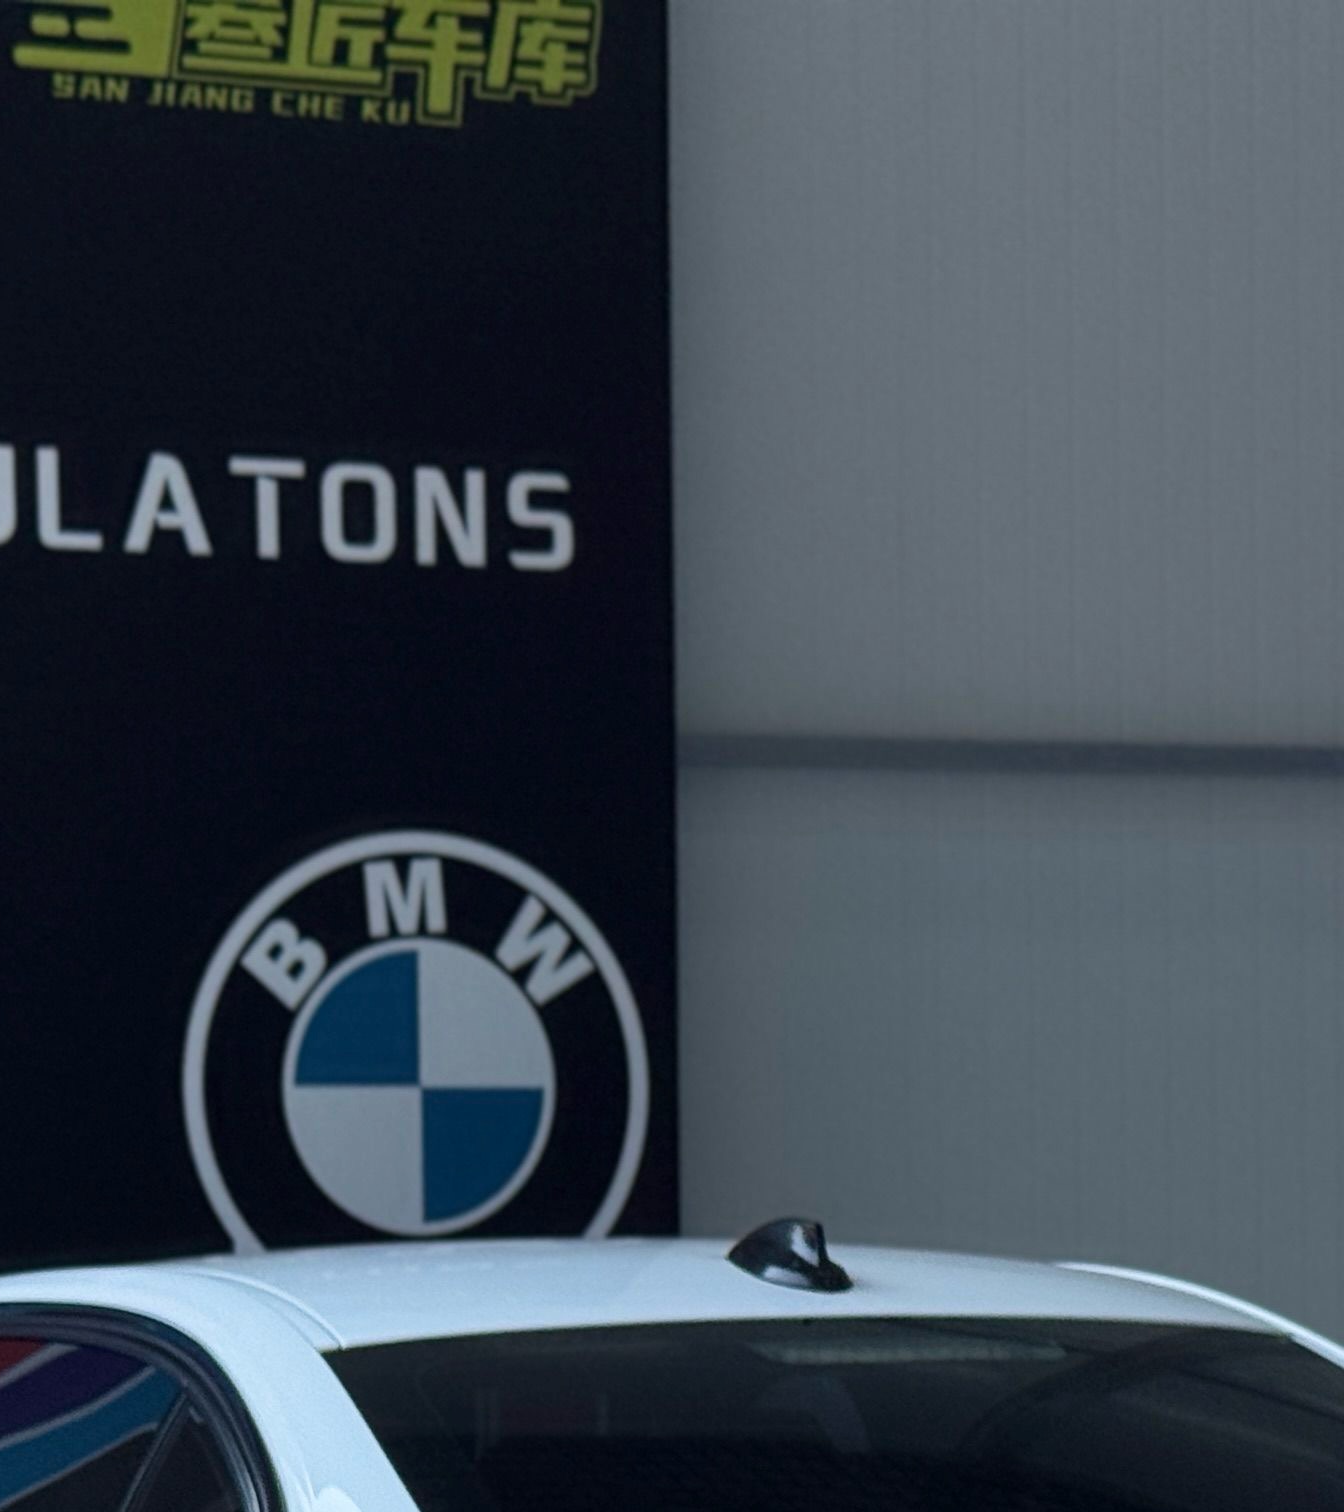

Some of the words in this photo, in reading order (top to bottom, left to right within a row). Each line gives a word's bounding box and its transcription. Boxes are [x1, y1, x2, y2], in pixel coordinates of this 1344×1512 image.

[51, 72, 131, 104] SAN
[147, 80, 255, 114] JIANG
[270, 89, 345, 122] CHE
[360, 98, 411, 127] KU
[240, 856, 595, 1012] BMW
